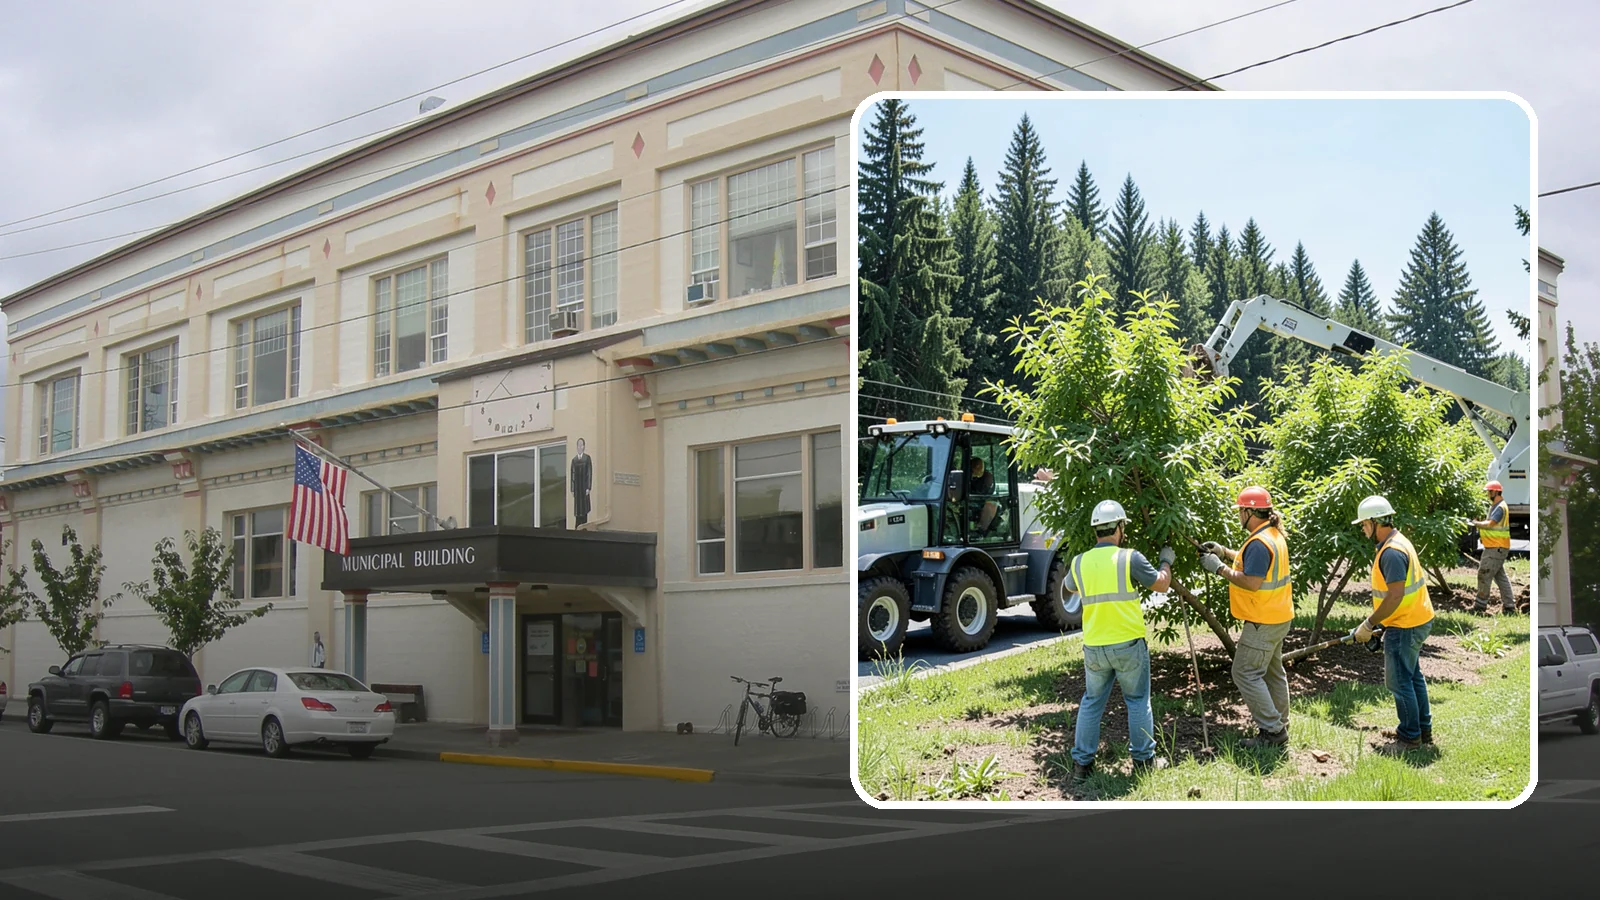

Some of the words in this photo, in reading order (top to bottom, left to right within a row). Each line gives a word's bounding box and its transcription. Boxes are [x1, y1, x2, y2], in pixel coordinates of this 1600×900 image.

[481, 407, 485, 415] 8
[501, 425, 506, 433] 11
[507, 425, 513, 433] 12
[521, 420, 525, 428] 2
[529, 414, 533, 422] 3
[536, 402, 540, 410] 4
[342, 553, 405, 572] MUNICIPAL
[414, 546, 475, 567] BUILDING
